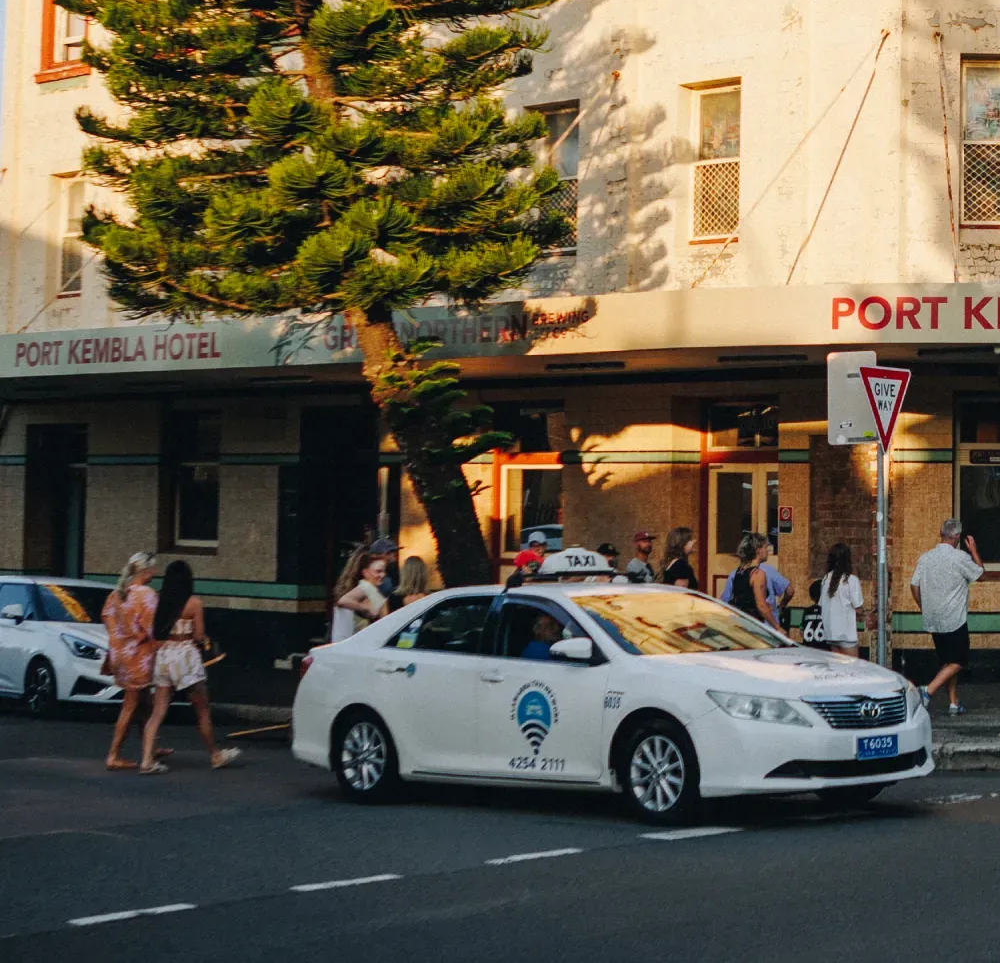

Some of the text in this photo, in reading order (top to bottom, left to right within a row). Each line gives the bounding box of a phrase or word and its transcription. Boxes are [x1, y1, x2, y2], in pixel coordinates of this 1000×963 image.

[532, 310, 589, 325] BREWING
[832, 296, 947, 330] PORT
[15, 332, 222, 367] PORT KEMBLA HOTEL
[874, 382, 896, 397] GIVE
[877, 400, 893, 411] WAY
[565, 555, 596, 567] TAXI
[803, 621, 825, 642] 66
[603, 696, 621, 709] 6035
[863, 736, 893, 750] T6035
[508, 756, 565, 771] 4254 2111
